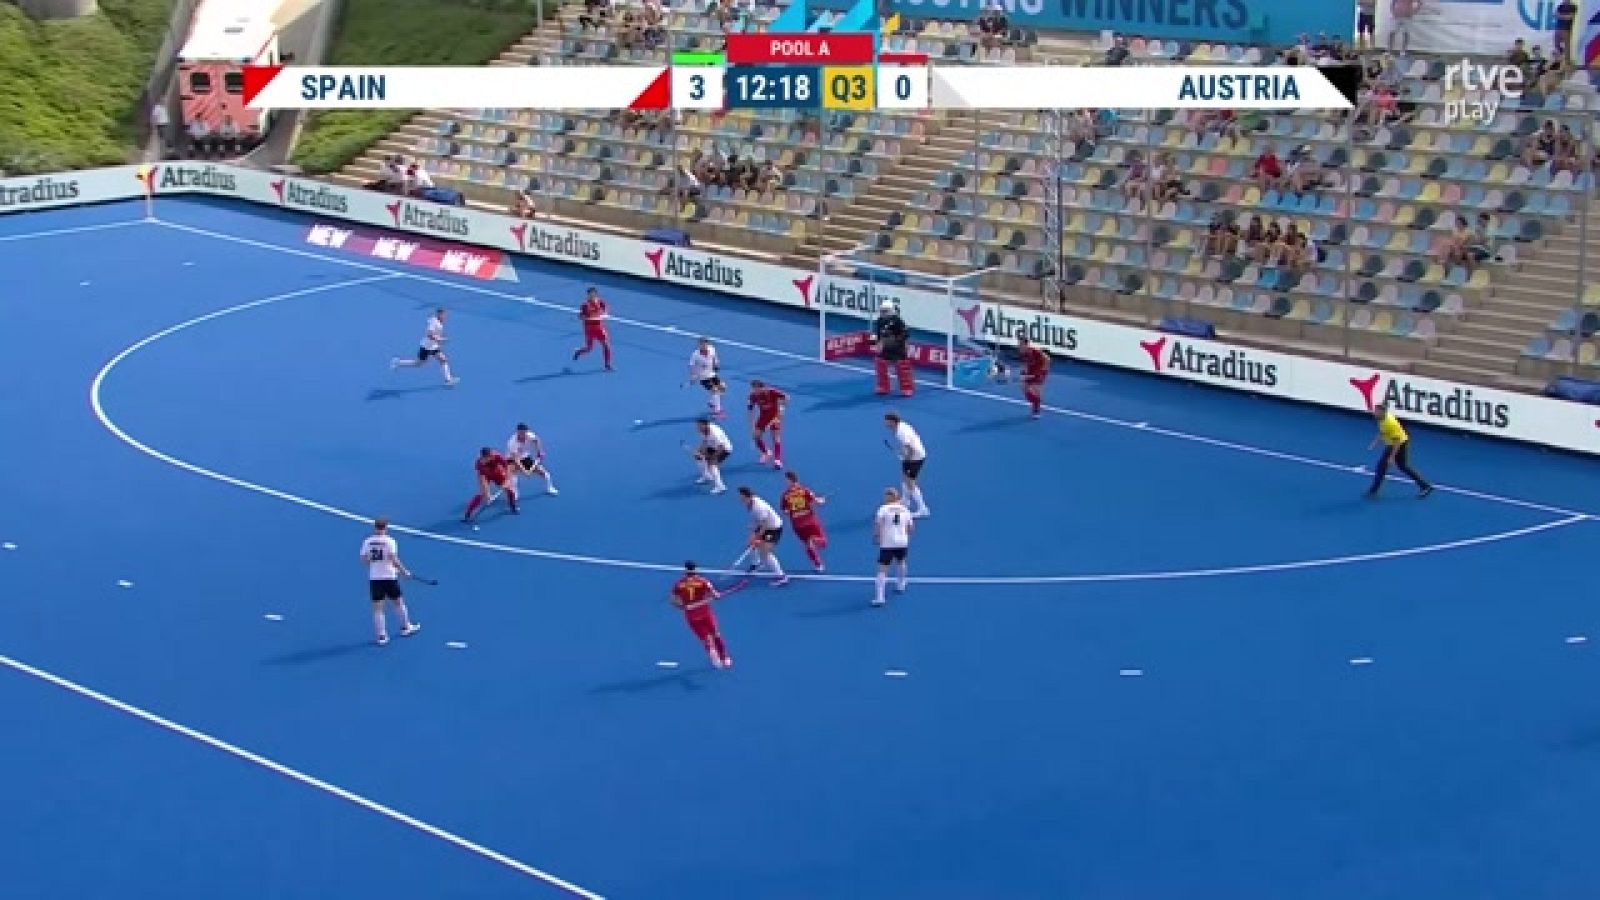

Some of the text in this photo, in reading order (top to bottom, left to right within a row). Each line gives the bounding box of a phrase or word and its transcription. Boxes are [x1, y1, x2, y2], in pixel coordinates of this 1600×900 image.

[0, 177, 80, 206] tradius
[160, 165, 237, 191] Atradius
[287, 180, 349, 214] Atradius
[402, 200, 470, 236] Atradius
[306, 224, 491, 276] NEW NEW NEW
[528, 225, 600, 260] Atradius
[664, 250, 743, 288] Atradius
[981, 307, 1078, 350] Atradius
[1167, 340, 1278, 386] Atradius
[1382, 379, 1509, 428] Atradius
